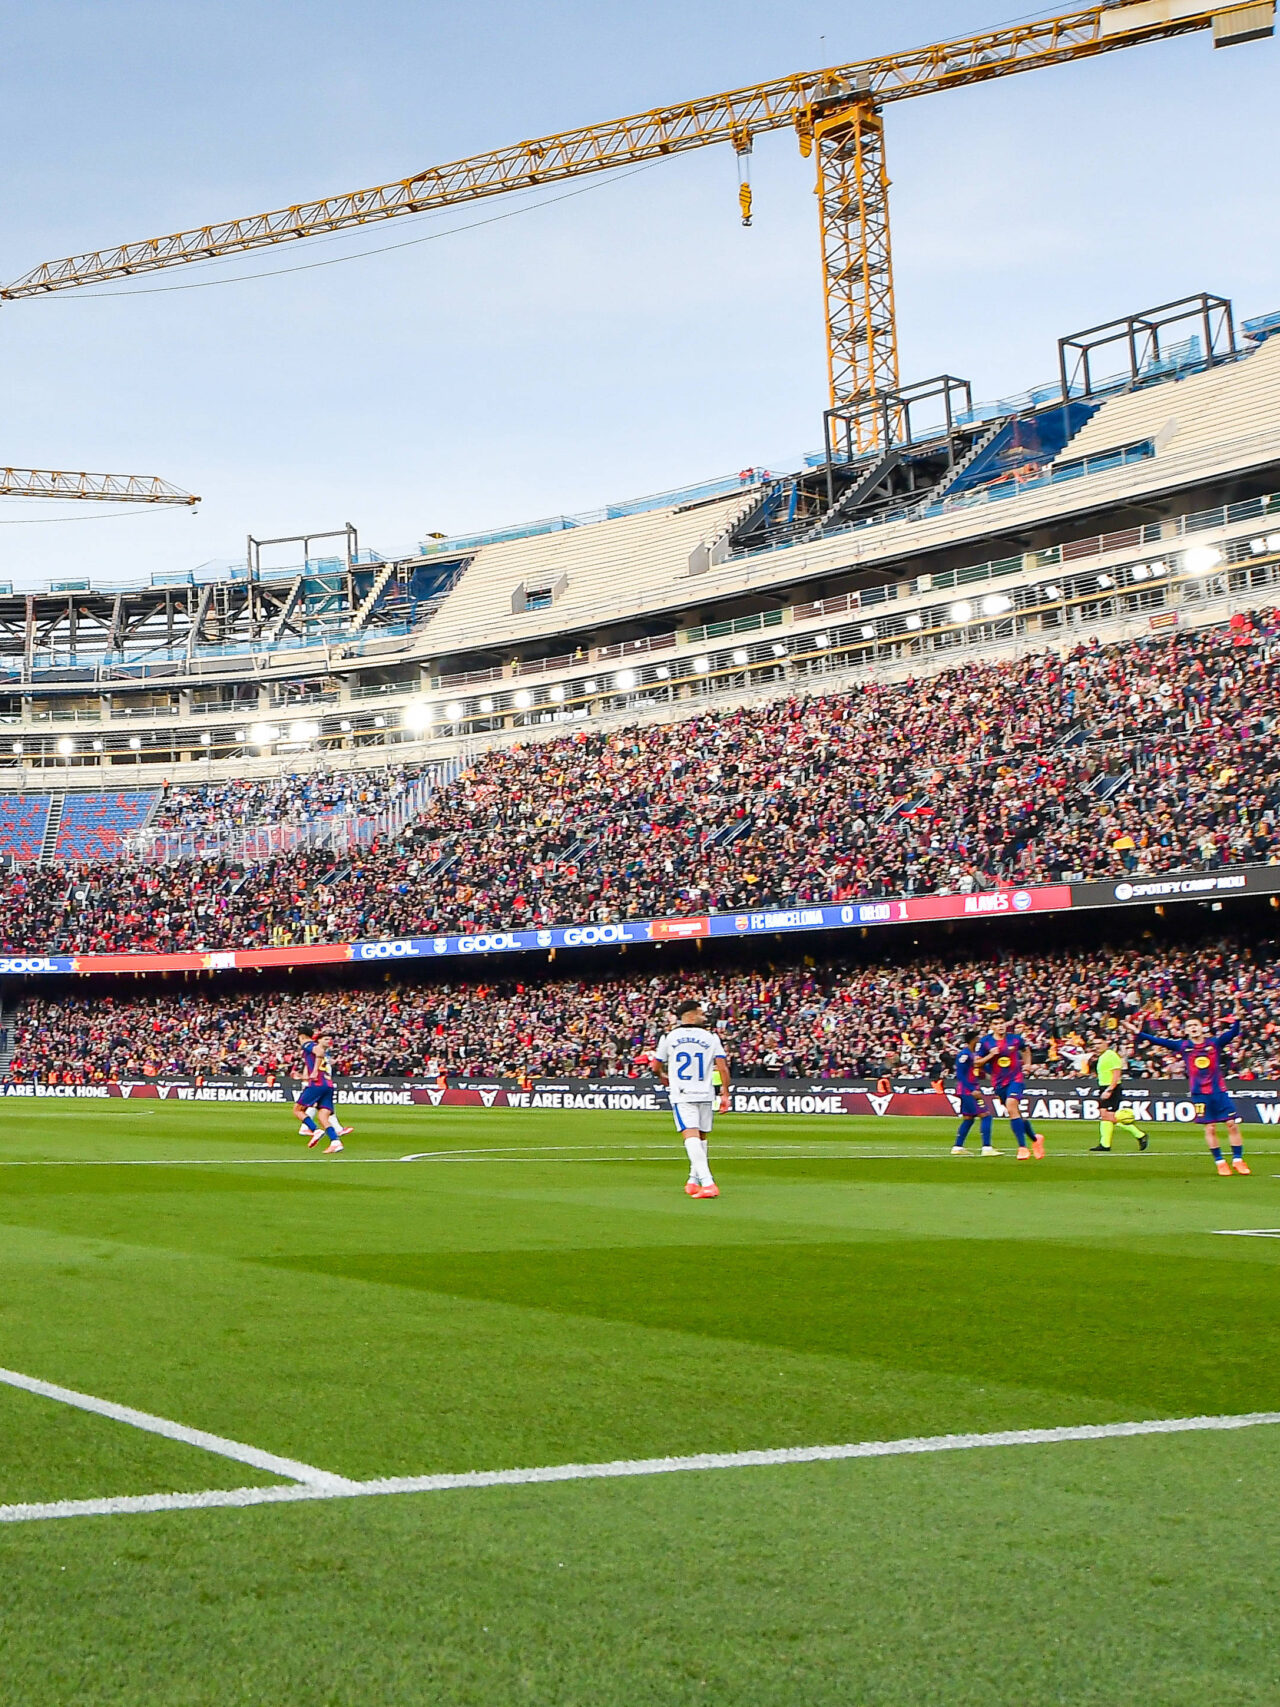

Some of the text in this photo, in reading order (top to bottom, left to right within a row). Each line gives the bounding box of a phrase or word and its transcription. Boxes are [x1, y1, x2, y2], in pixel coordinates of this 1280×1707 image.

[751, 910, 824, 929] FC BARCELONA
[841, 906, 853, 923] 0
[898, 902, 908, 919] 1
[458, 933, 522, 952] GOOL
[564, 925, 633, 945] GOOL
[361, 941, 419, 959] GOOL
[676, 1052, 704, 1081] 21
[5, 1084, 34, 1097] ARE
[36, 1085, 75, 1098] BACK
[76, 1085, 110, 1098] HOME.
[177, 1088, 194, 1100] WE
[195, 1088, 217, 1100] ARE
[218, 1088, 251, 1101] BACK
[252, 1089, 286, 1102] HOME.
[338, 1091, 373, 1104] BACK
[374, 1091, 414, 1105] HOME.
[507, 1093, 660, 1110] WE ARE BACK HOME.
[734, 1095, 785, 1112] BACK
[787, 1095, 847, 1113] HOME.
[1031, 1100, 1080, 1119] ARE
